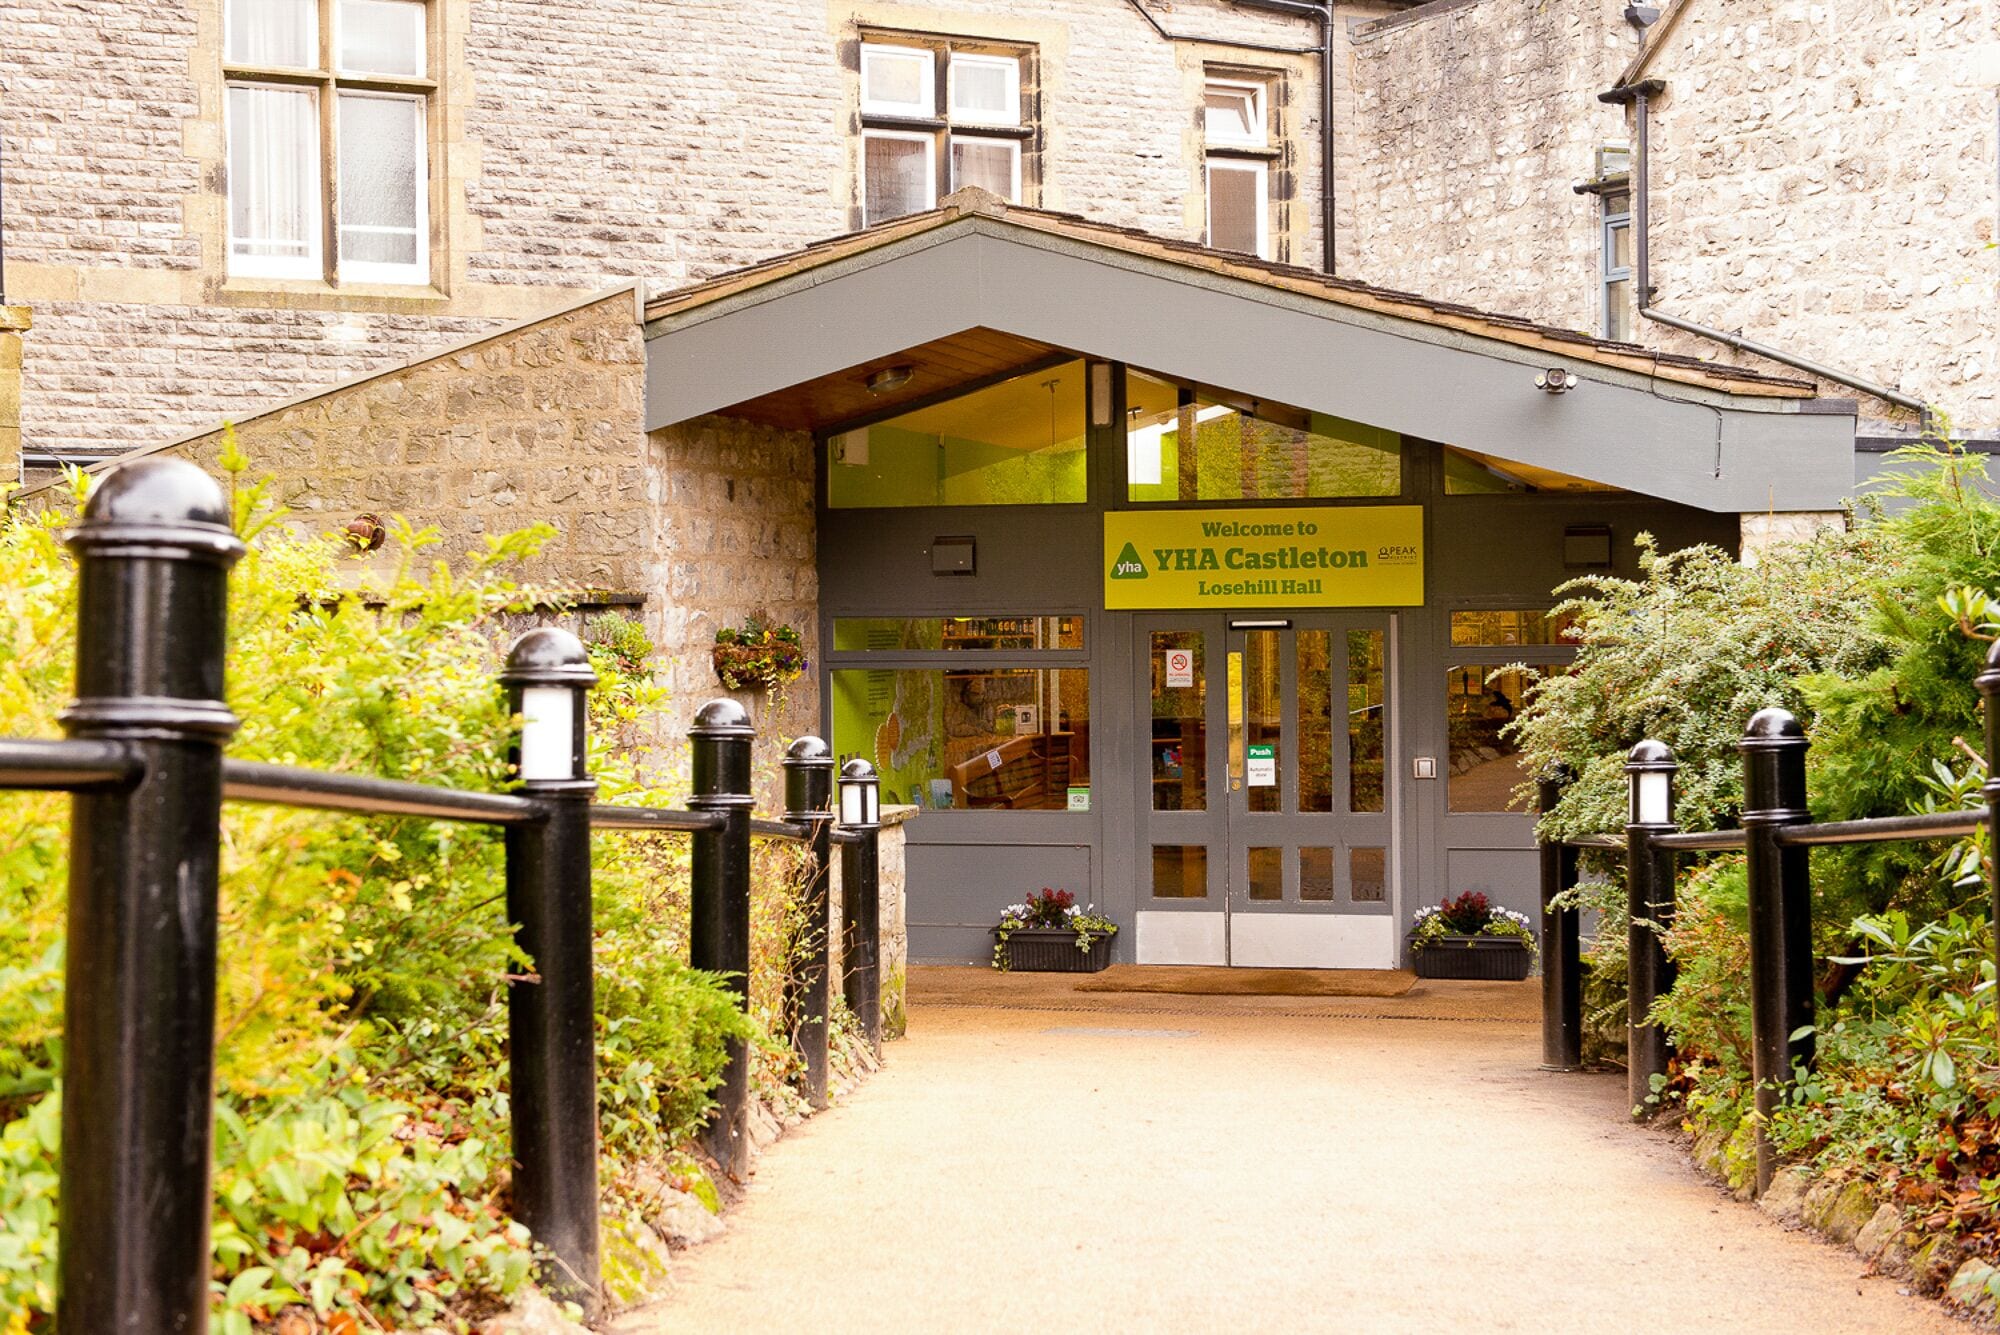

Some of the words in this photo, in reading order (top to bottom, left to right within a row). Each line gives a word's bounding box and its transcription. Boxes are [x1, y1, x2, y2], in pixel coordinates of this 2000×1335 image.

[1201, 521, 1294, 537] Welcome
[1297, 520, 1318, 536] to
[1152, 548, 1220, 571] YHA
[1224, 546, 1369, 570] Castleton
[1390, 546, 1417, 555] PEAK
[1117, 561, 1142, 576] yha
[1198, 579, 1278, 596] Losehill
[1280, 579, 1323, 595] Hall
[1250, 748, 1272, 756] Push
